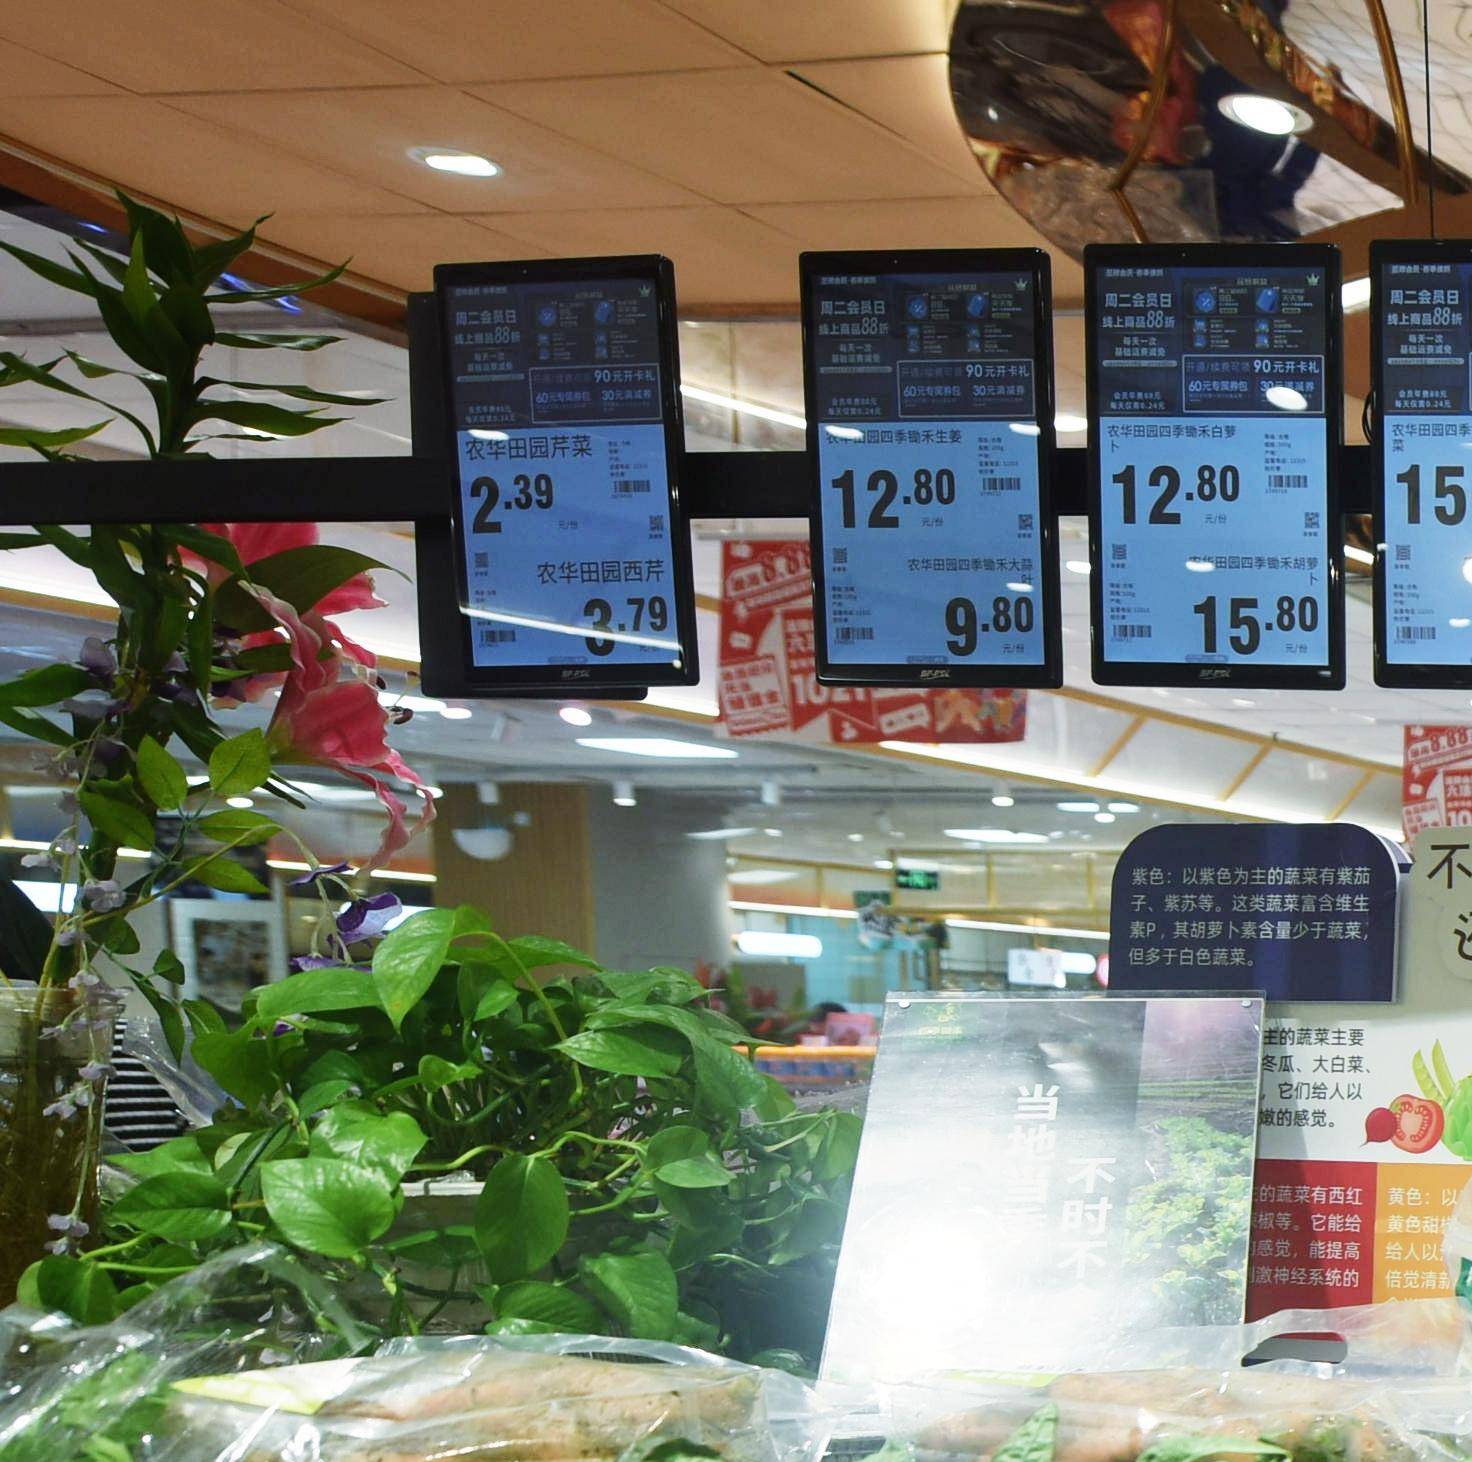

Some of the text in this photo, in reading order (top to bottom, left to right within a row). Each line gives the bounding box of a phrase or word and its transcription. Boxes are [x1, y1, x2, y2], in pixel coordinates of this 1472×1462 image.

[1105, 293, 1172, 308] 周二会员日
[1390, 290, 1459, 305] 周二会员日
[1387, 307, 1462, 326] 线上商品88折
[1253, 360, 1319, 374] 90元开卡礼
[826, 429, 962, 445] 农田园四季锄禾生姜
[1107, 424, 1236, 439] 农华田园四季锄禾白萝
[465, 434, 592, 461] 农华田园芹菜
[470, 473, 554, 534] 2.39
[831, 468, 956, 529] 12.80
[1112, 464, 1240, 525] 12.80
[537, 559, 664, 585] 农华田园西芹
[584, 596, 668, 656] 3.79
[945, 597, 1034, 656] 9.80
[1193, 596, 1318, 655] 15.80
[1129, 948, 1255, 968] 但多于白色蔬菜。
[1253, 1214, 1361, 1233] 椒等。它能给
[1385, 1242, 1452, 1260] 给人以
